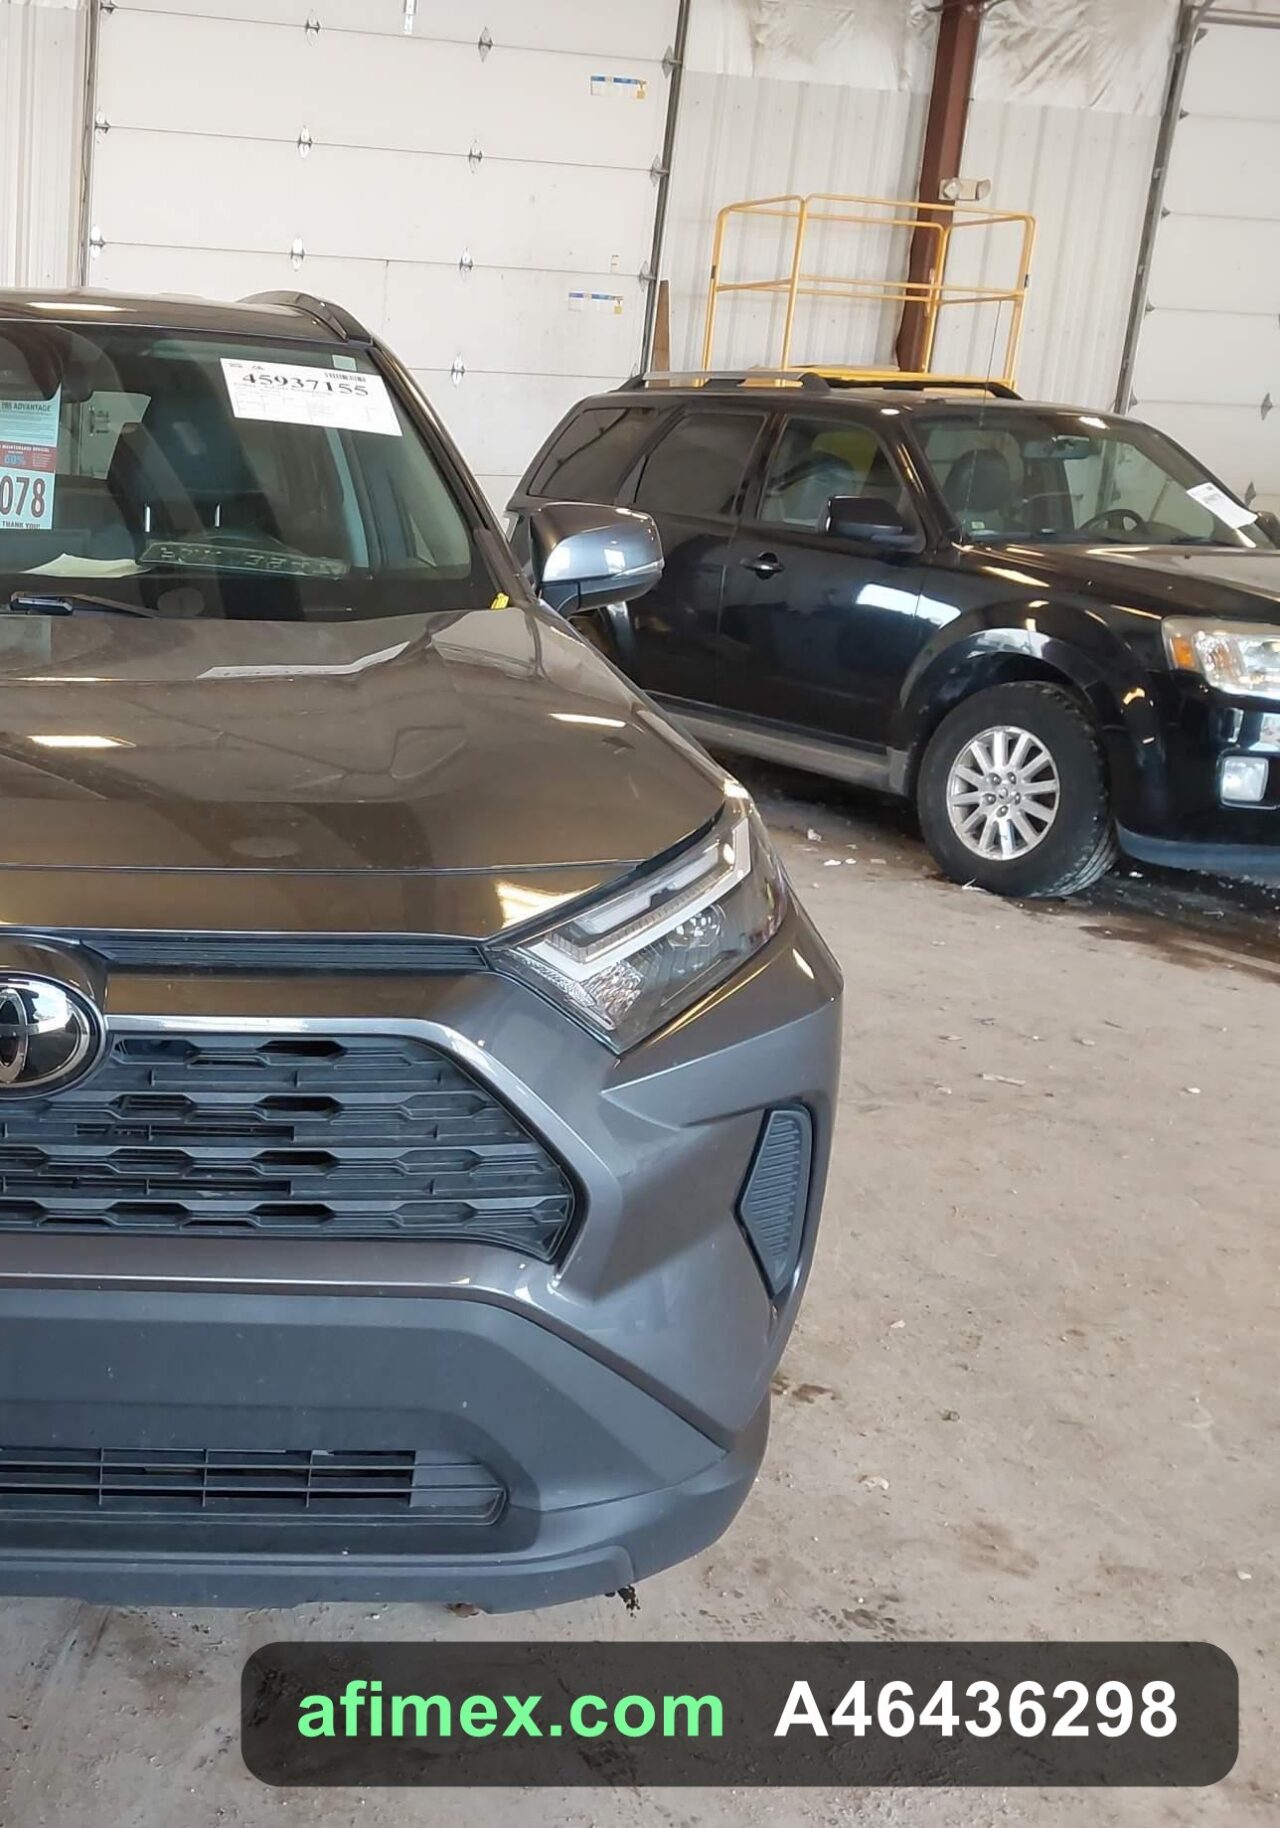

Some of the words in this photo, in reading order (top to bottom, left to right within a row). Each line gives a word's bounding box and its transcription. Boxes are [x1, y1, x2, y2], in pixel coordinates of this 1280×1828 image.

[242, 372, 369, 397] 45937155
[13, 402, 51, 412] ADVANTAGE
[2, 520, 24, 528] THANK
